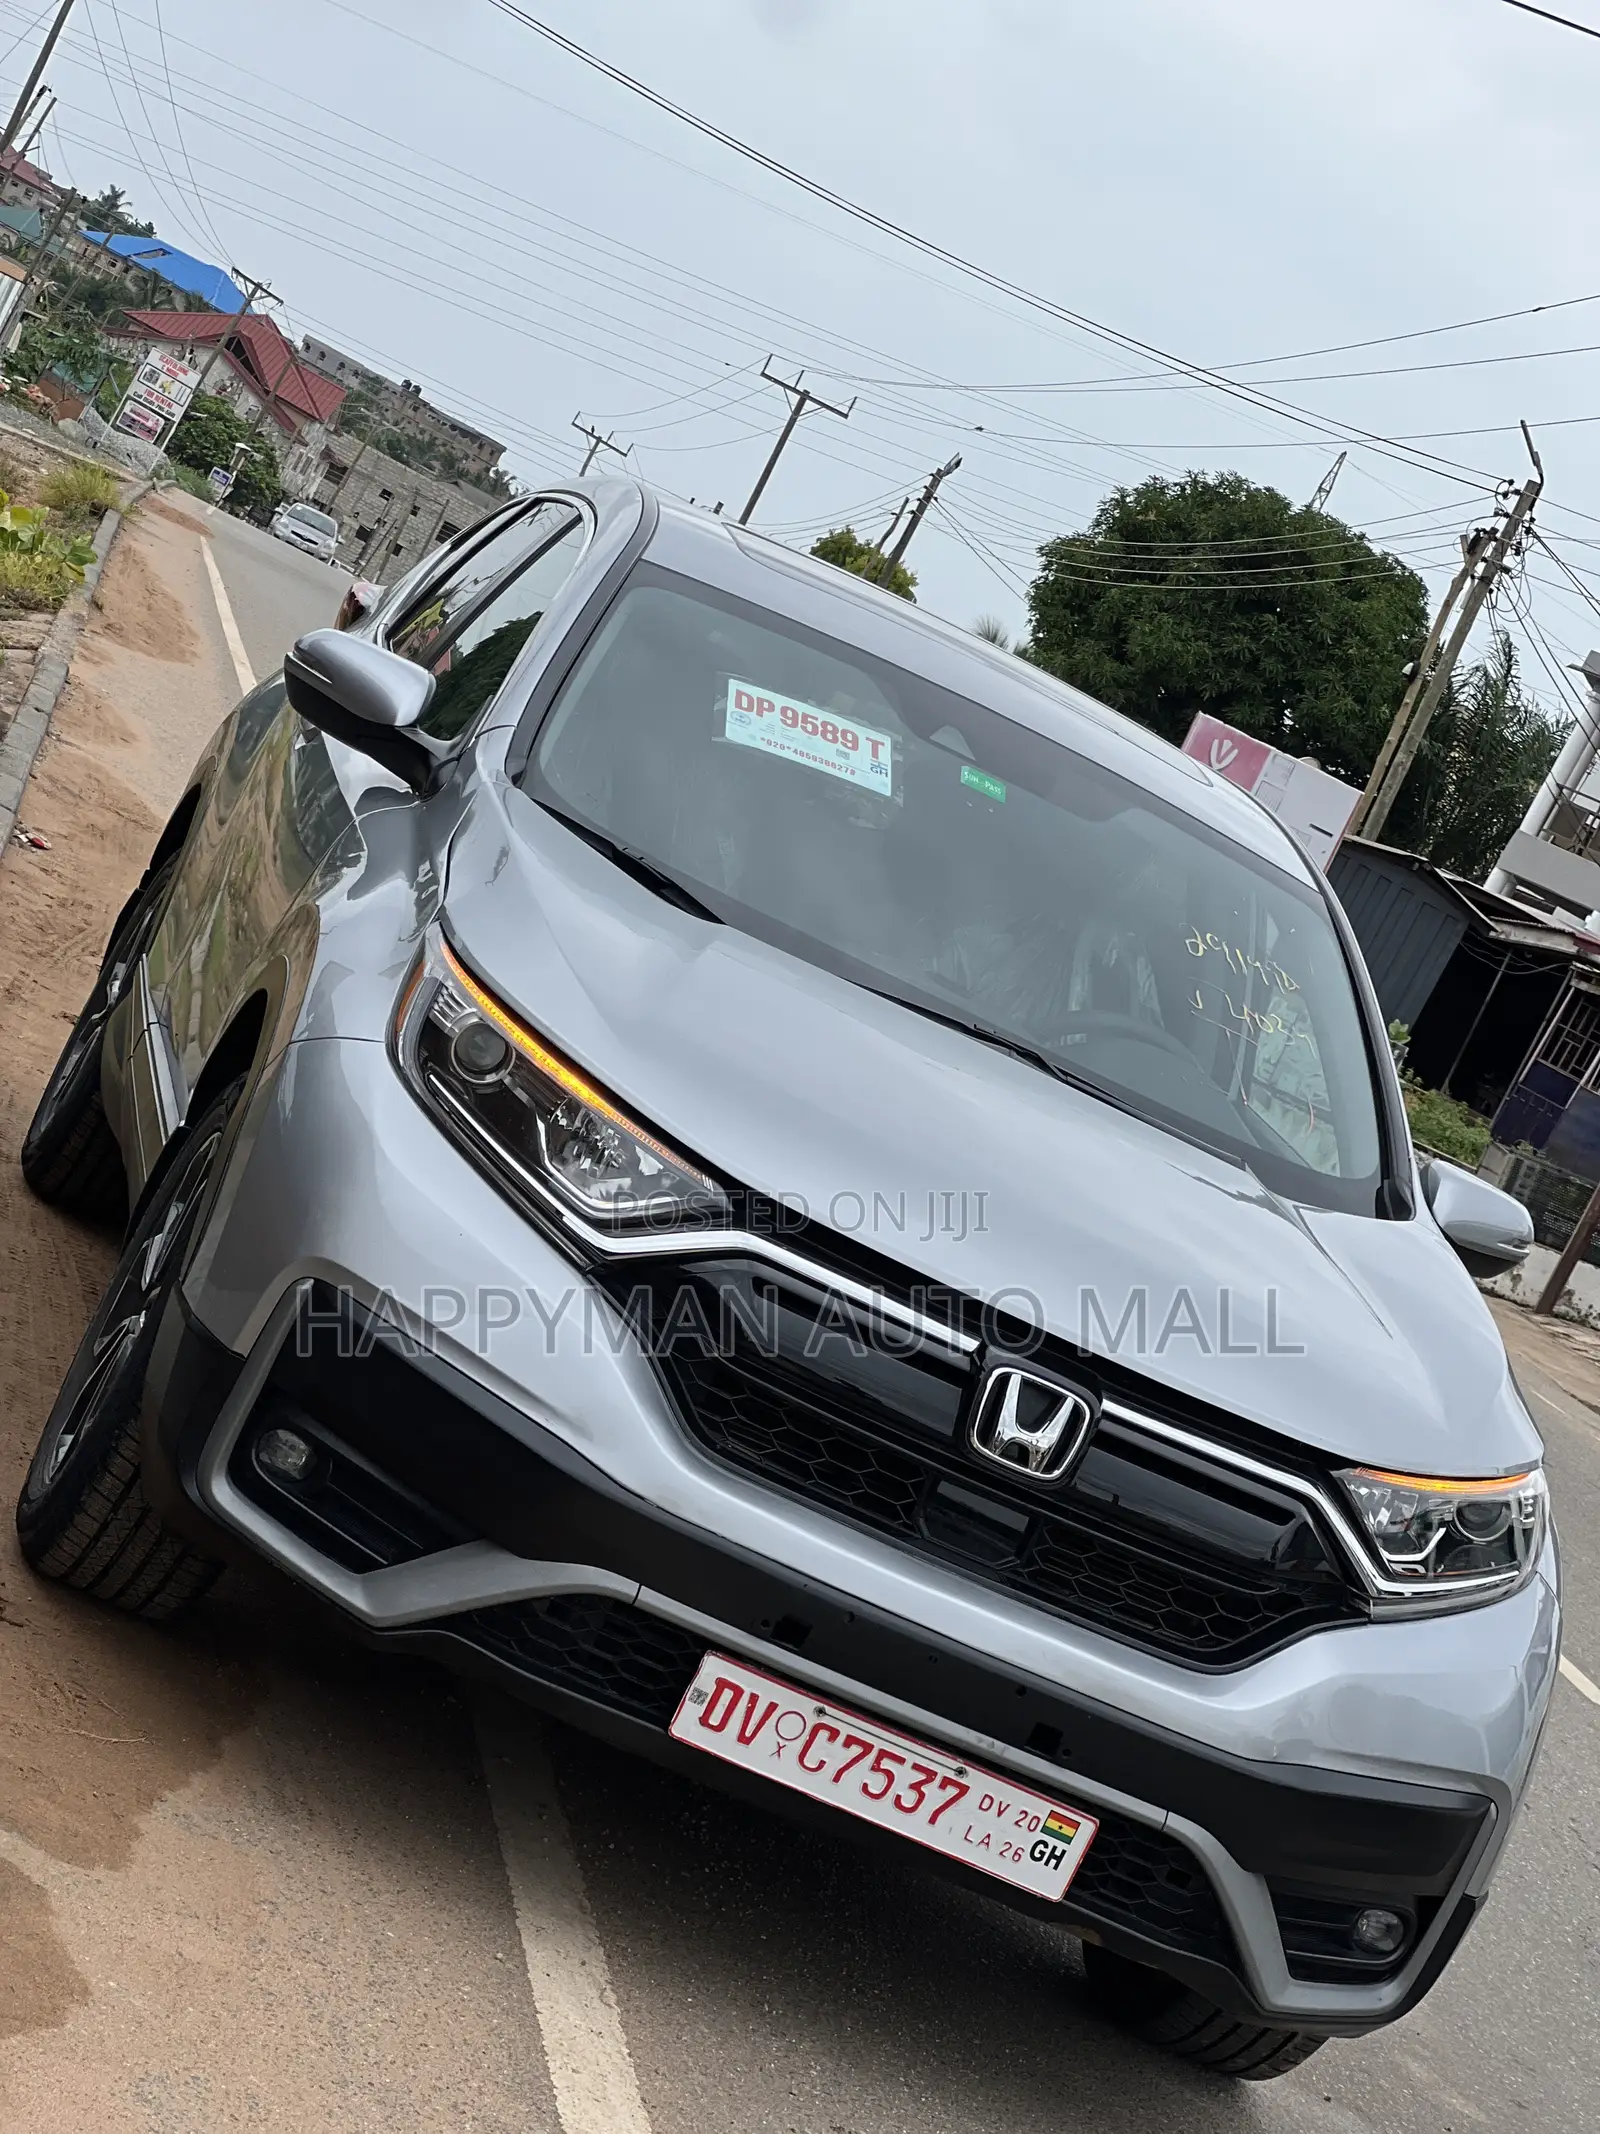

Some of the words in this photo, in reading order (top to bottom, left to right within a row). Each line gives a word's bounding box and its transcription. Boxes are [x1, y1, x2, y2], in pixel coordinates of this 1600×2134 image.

[734, 688, 776, 718] DP
[779, 705, 859, 752] 9589
[865, 736, 885, 760] T
[870, 766, 889, 778] GH
[698, 1676, 779, 1746] DV
[797, 1721, 971, 1827] C7537
[978, 1793, 1011, 1818] DV
[1014, 1809, 1041, 1832] 20
[963, 1825, 992, 1850] LA
[999, 1841, 1025, 1863] 26
[1029, 1839, 1067, 1871] GH
